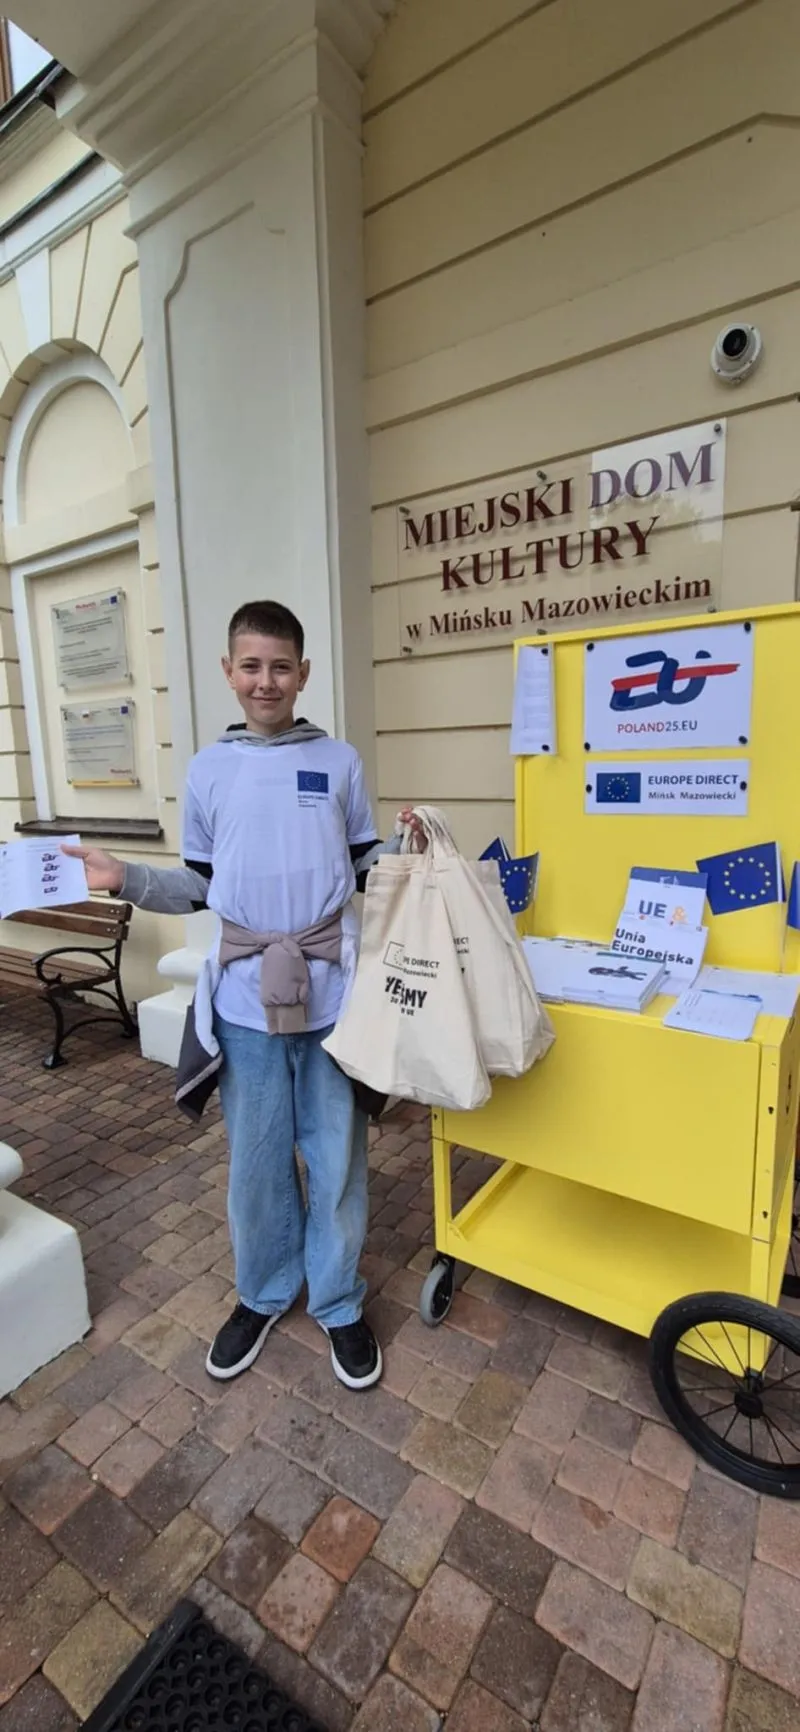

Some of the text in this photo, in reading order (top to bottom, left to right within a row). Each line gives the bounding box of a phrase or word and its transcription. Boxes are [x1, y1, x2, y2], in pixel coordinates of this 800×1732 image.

[404, 442, 716, 550] MIEJSKI DOM
[441, 515, 660, 592] KULTURY
[406, 576, 711, 639] w Mińsku Mazowieckim
[617, 720, 698, 733] POLAND25.EU
[648, 774, 740, 785] EUROPE DIRECT
[648, 790, 737, 800] Mińsk Mazowiecki
[639, 900, 667, 919] UE
[615, 928, 646, 944] Unia
[611, 940, 694, 964] Europejska
